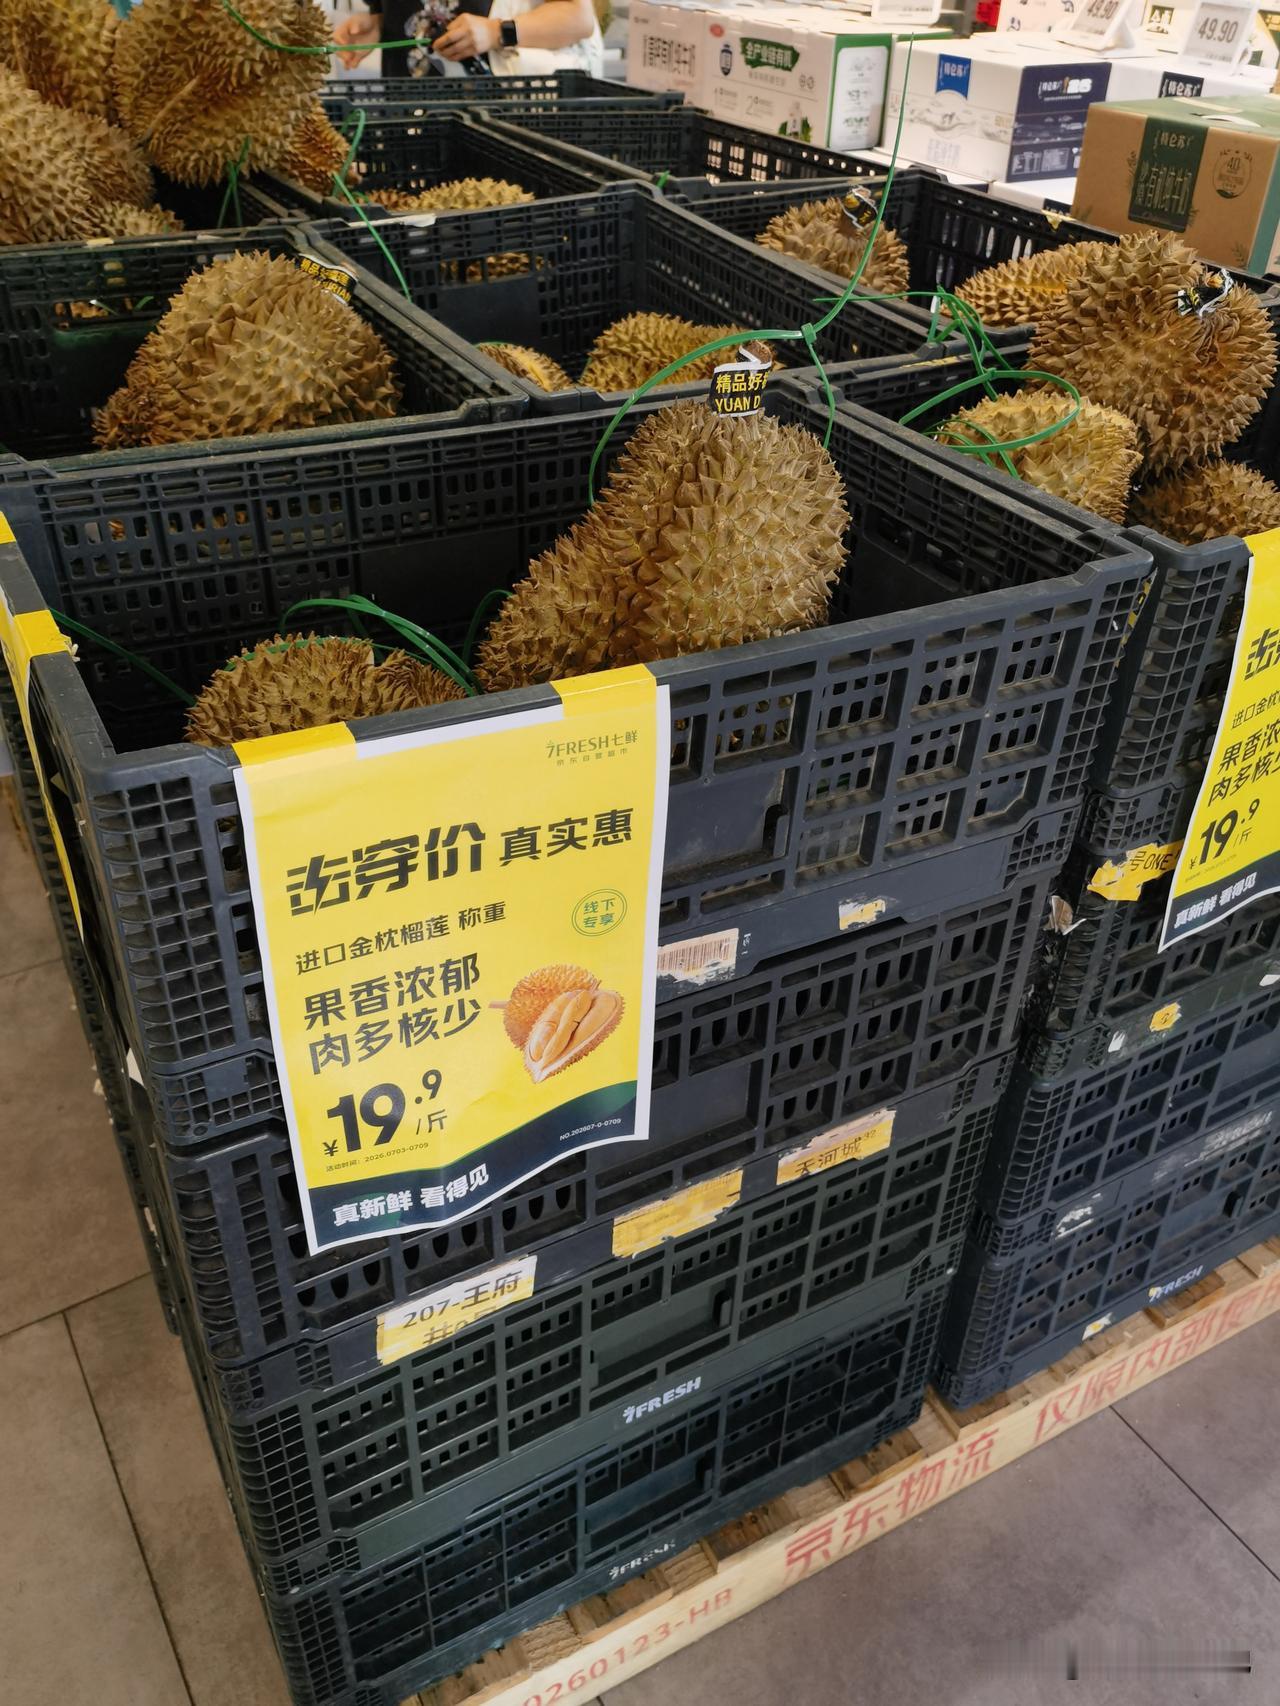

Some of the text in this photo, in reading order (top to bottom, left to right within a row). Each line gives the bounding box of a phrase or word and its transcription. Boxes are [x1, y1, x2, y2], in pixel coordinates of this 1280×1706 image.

[1198, 17, 1239, 43] 49.90
[715, 396, 751, 412] YUAN
[1244, 627, 1280, 681] 击
[286, 808, 634, 915] 击穿价 真实惠
[583, 898, 616, 915] 线下
[583, 913, 615, 928] 专享
[1174, 872, 1258, 929] 真新鲜 看得见
[295, 901, 506, 976] 进口金枕榴莲 称重
[304, 952, 481, 1031] 果香浓郁
[308, 998, 482, 1075] 肉多核少
[332, 1163, 489, 1227] 真新鲜 看得见
[403, 1270, 523, 1329] 207-王府
[623, 1376, 702, 1424] 7FRESH
[784, 1428, 1000, 1584] 京东物流
